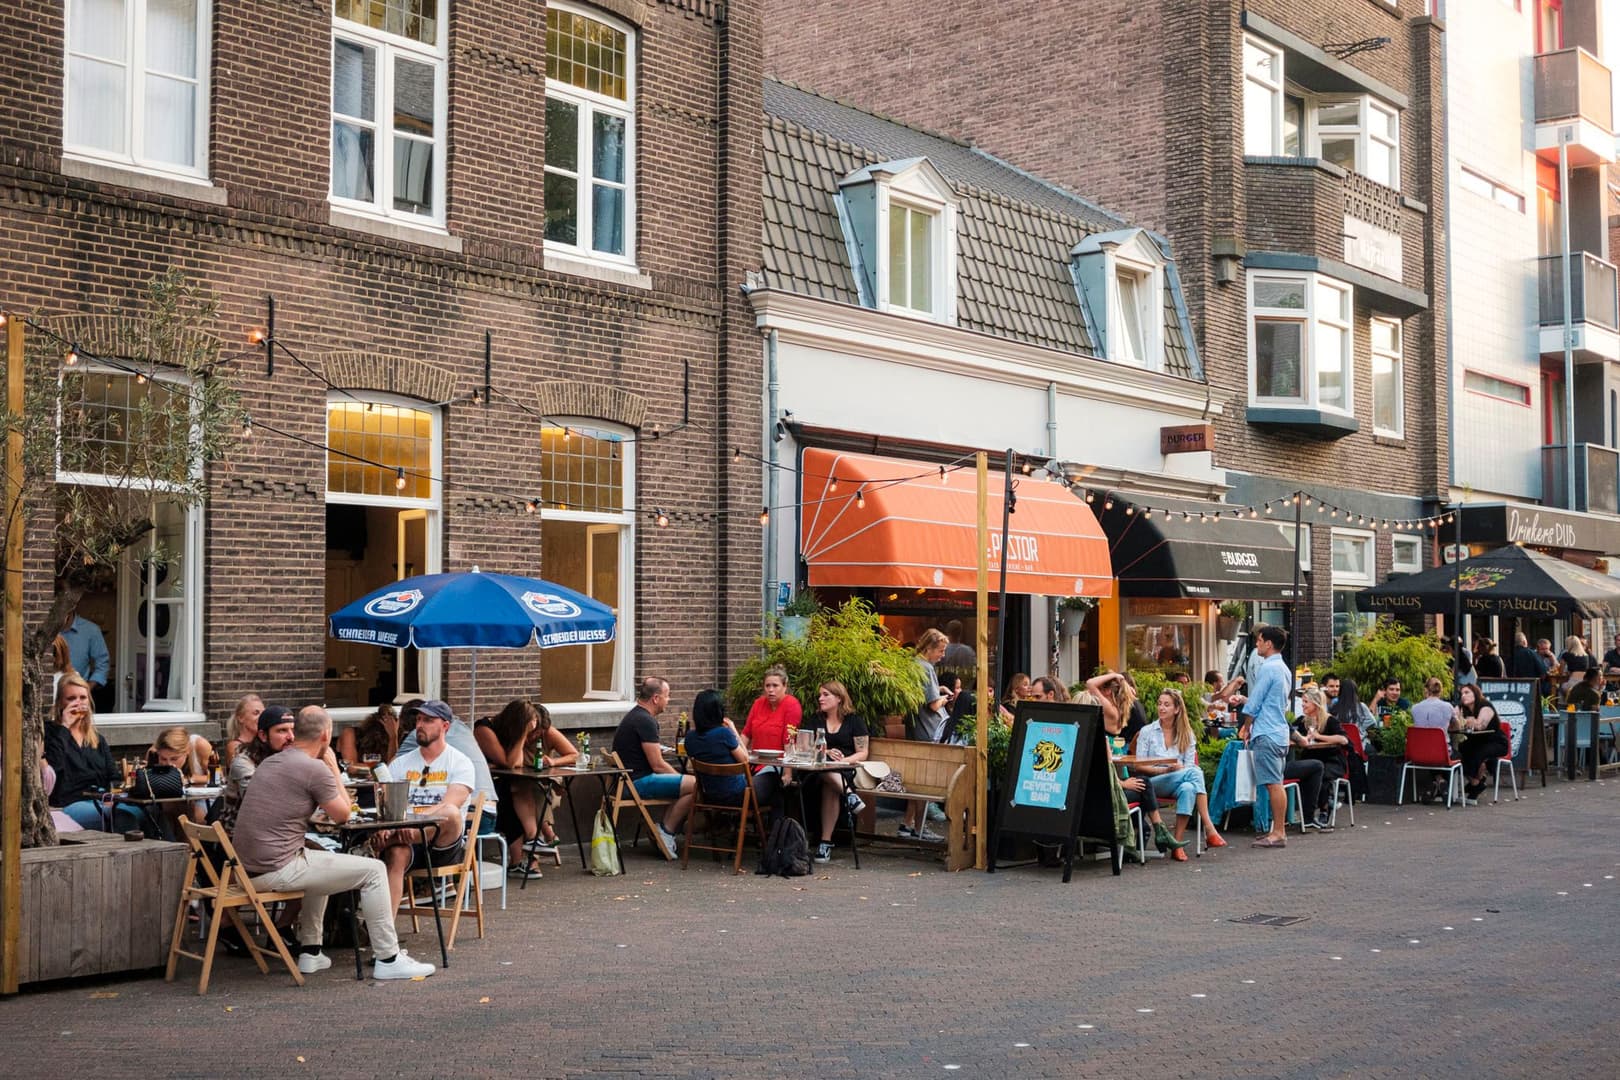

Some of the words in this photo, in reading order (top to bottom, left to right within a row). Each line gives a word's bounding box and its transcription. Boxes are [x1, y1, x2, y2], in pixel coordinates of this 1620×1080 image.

[1167, 432, 1204, 444] BURGER
[1509, 509, 1554, 543] Drinkers
[1555, 522, 1576, 547] PUB
[991, 533, 1039, 562] PSTOR
[1226, 551, 1259, 567] BURGER
[1370, 594, 1422, 611] Lupulus
[578, 629, 607, 641] WEISSE
